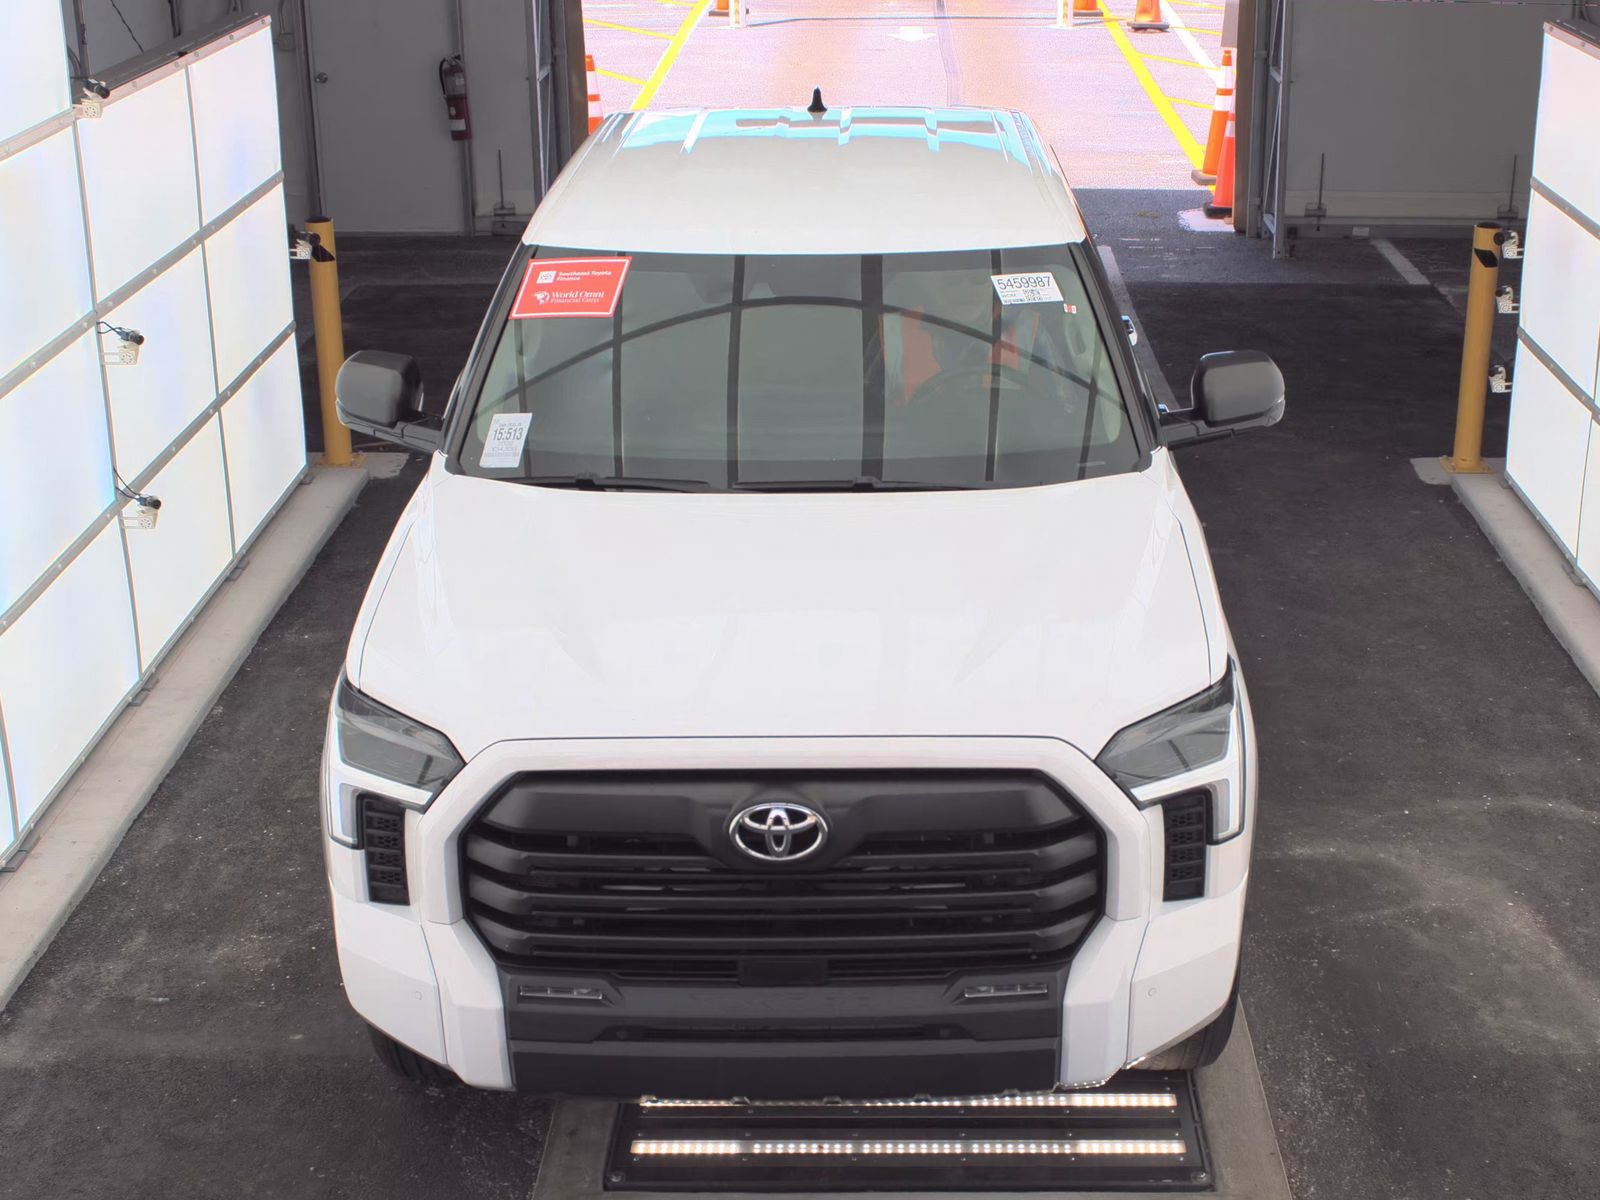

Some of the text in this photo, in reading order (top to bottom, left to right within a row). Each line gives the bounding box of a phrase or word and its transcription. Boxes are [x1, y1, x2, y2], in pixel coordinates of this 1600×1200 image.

[997, 276, 1051, 290] 5459987
[552, 290, 605, 298] World Omni
